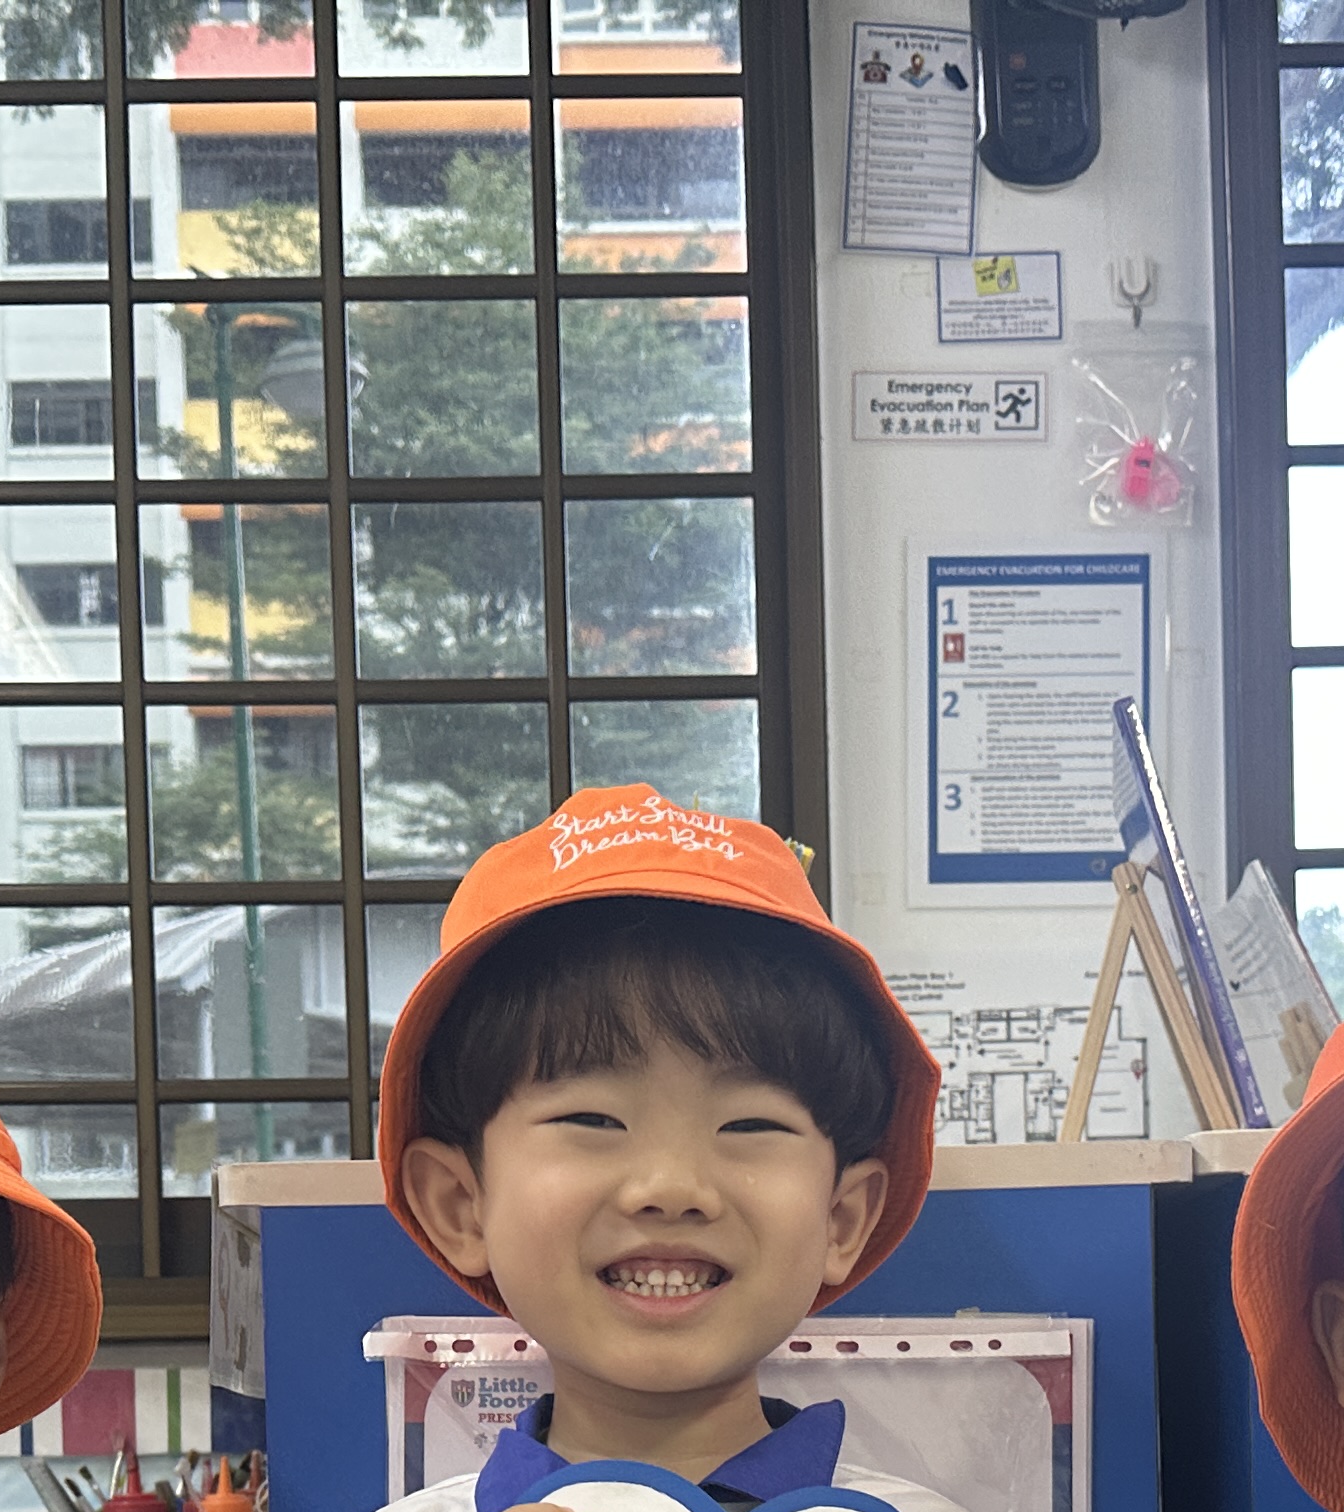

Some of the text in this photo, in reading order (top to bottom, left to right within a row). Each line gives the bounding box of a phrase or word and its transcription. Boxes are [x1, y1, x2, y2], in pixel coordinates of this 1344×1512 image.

[888, 380, 973, 396] Emergency
[870, 399, 990, 413] Evacuation Plan
[935, 563, 1140, 577] EMERGENCY EVACUATION FOR CHILDCARE
[942, 598, 958, 626] 1
[942, 690, 959, 718] 2
[944, 783, 962, 811] 3
[549, 796, 732, 850] Start Small
[552, 826, 745, 873] Dream Big
[478, 1377, 538, 1393] Little
